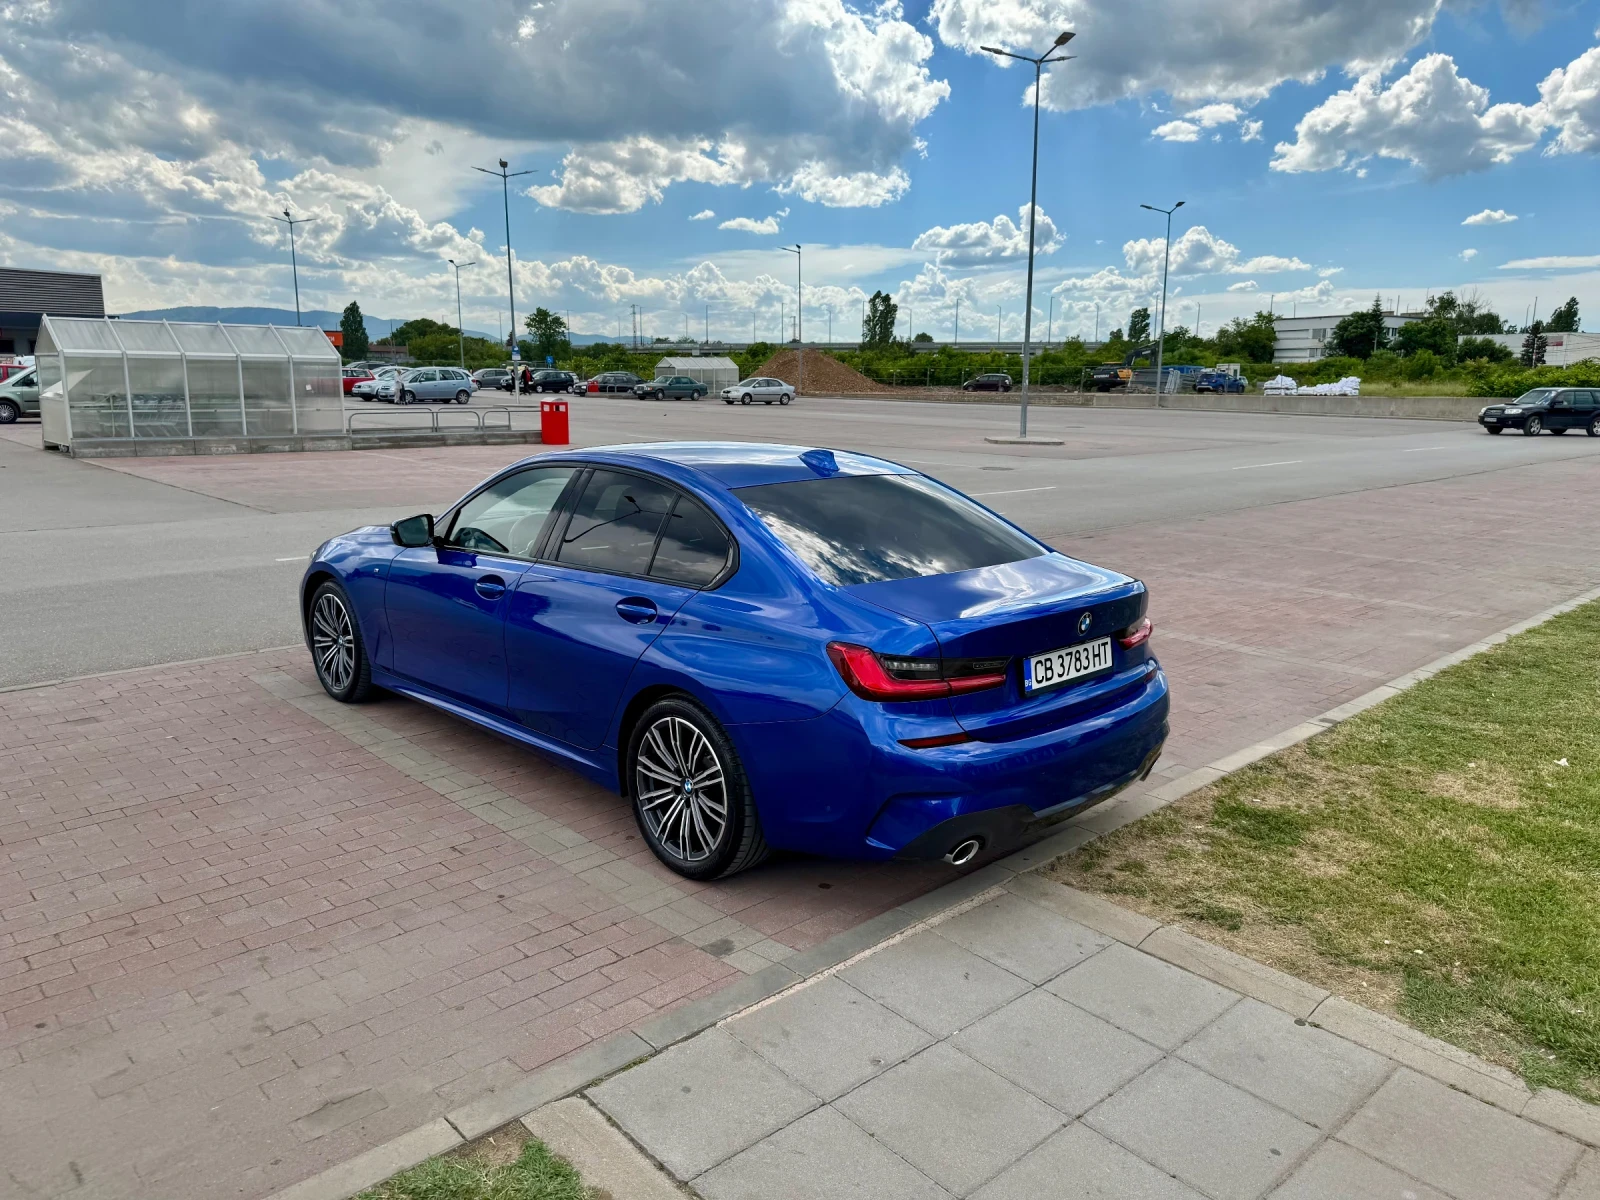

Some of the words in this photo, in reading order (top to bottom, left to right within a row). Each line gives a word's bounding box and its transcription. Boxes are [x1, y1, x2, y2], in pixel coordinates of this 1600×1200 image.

[1034, 658, 1054, 684] CB
[1057, 648, 1090, 678] 3783
[1092, 641, 1109, 668] HT
[1025, 679, 1032, 687] BG
